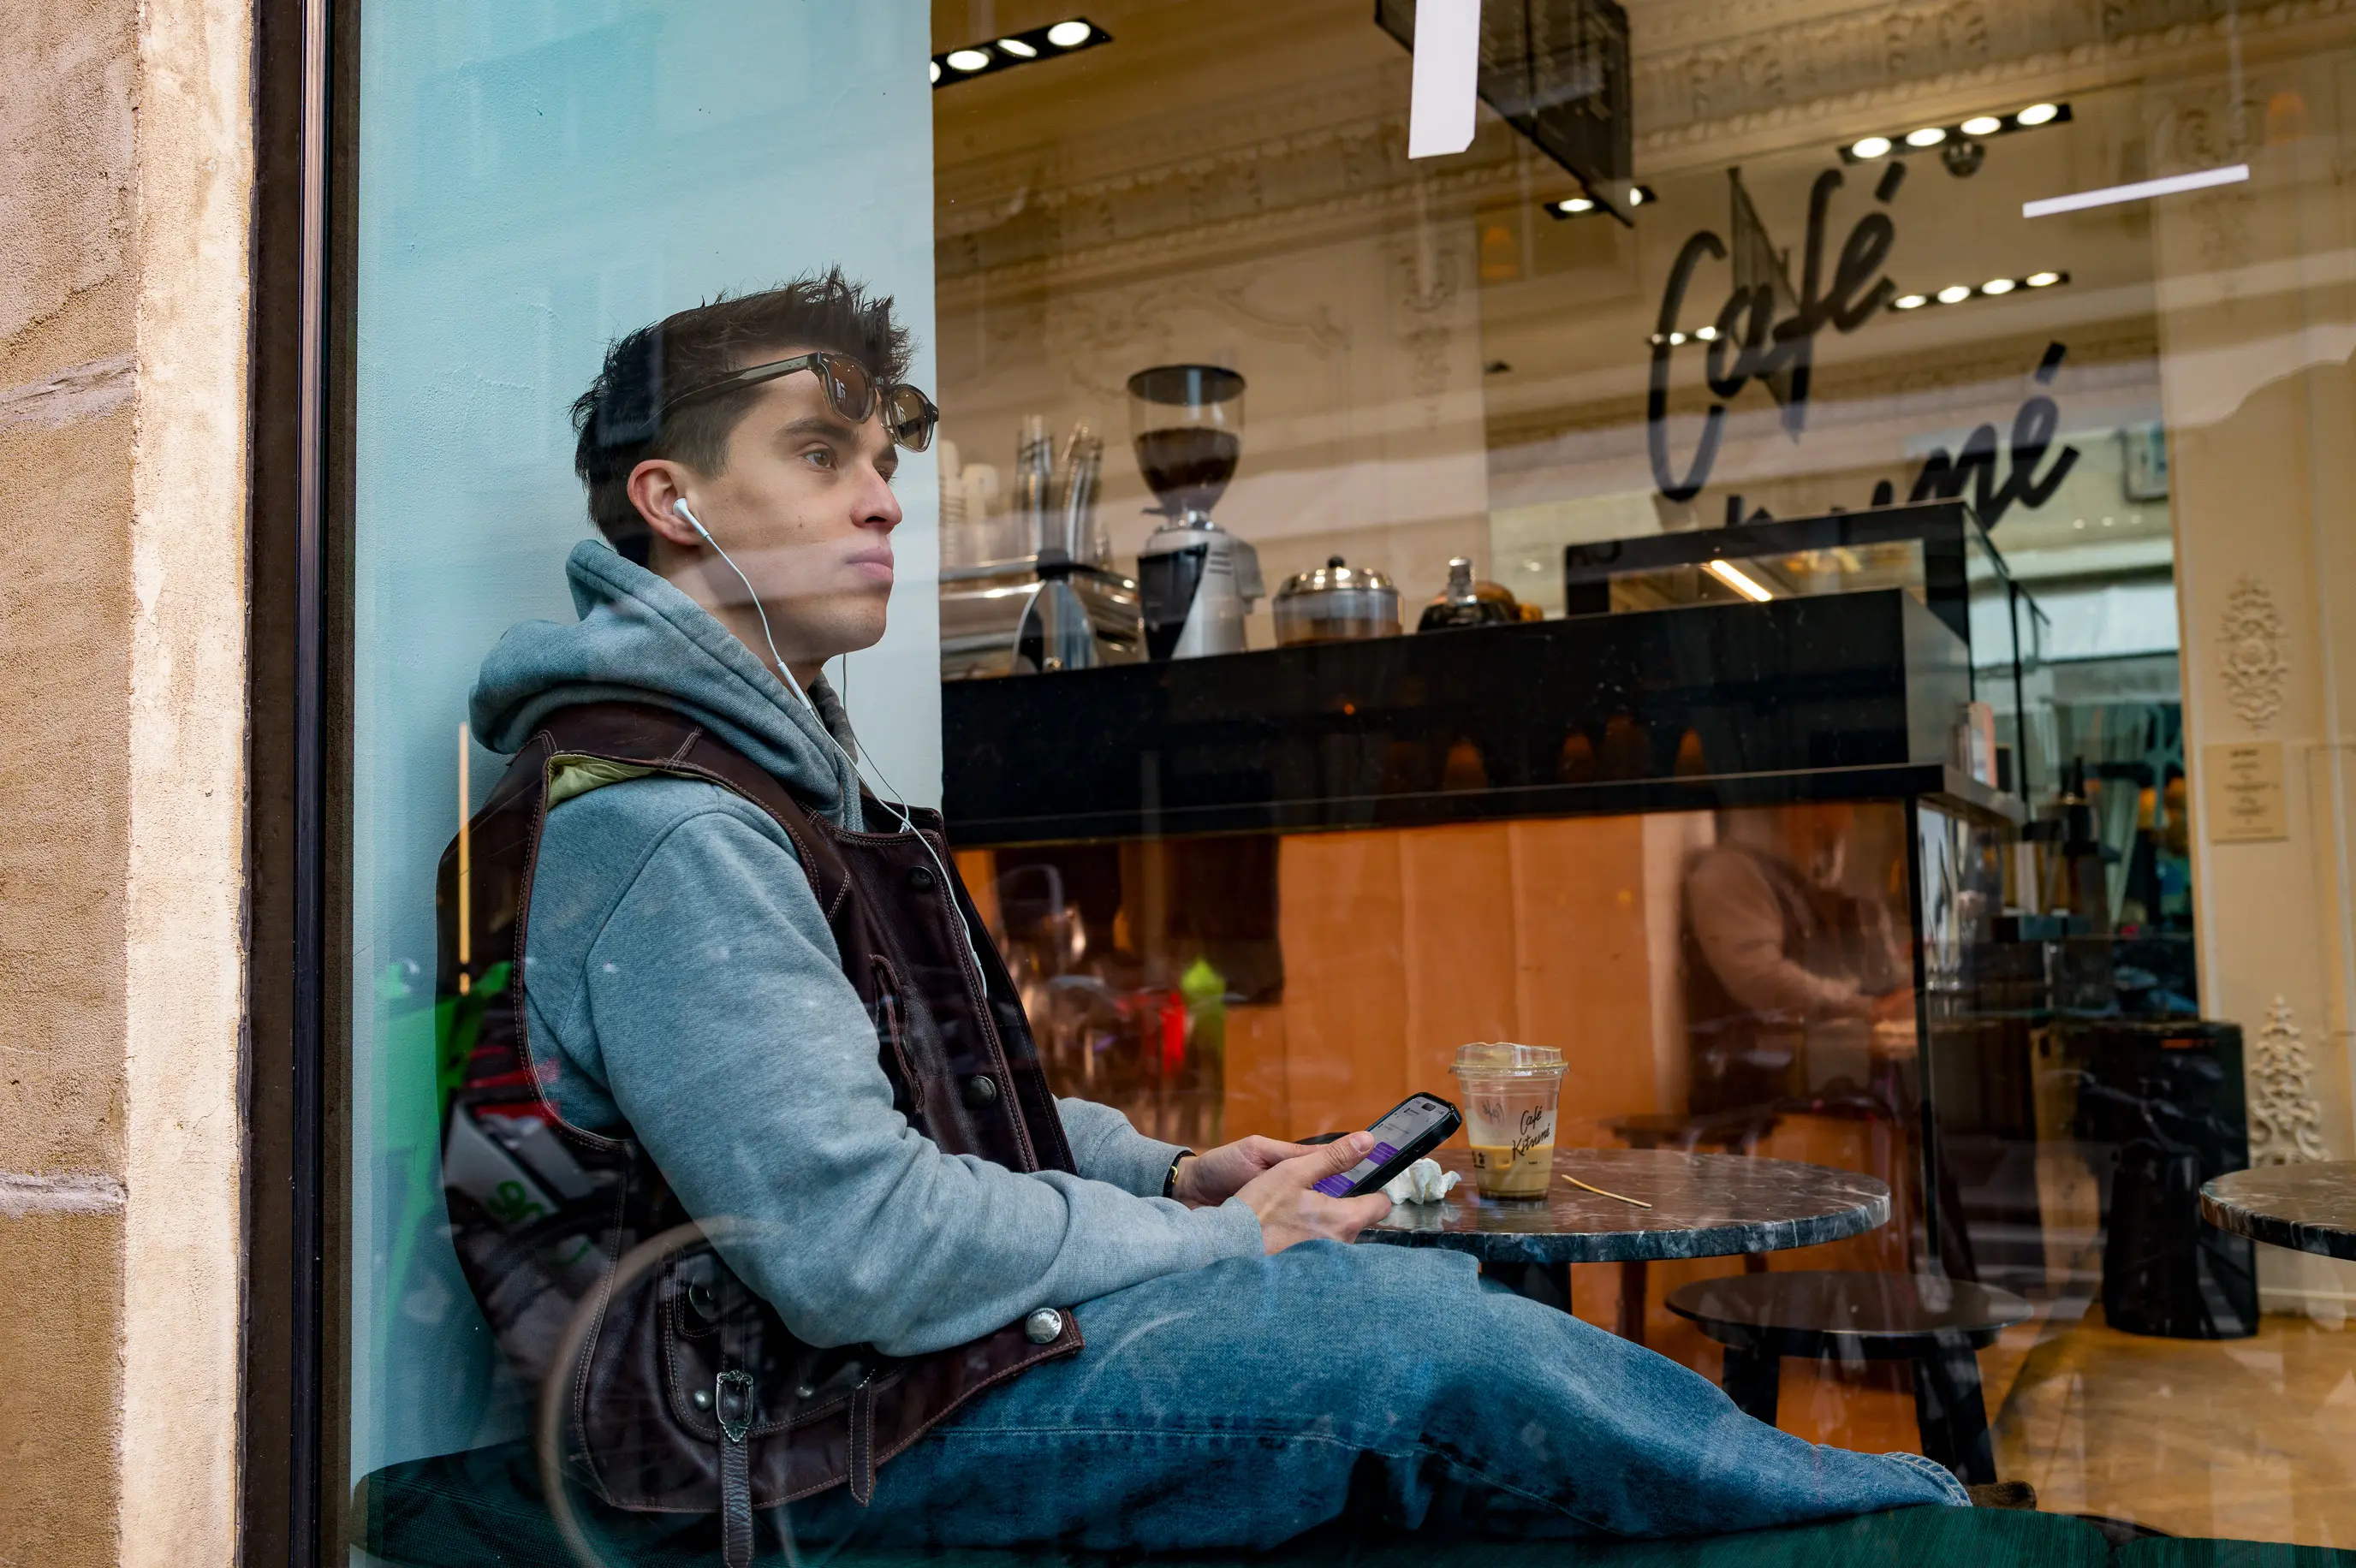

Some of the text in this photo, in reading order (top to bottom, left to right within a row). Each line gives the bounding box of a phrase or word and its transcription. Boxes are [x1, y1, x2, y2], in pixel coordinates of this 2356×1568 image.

[1647, 161, 1906, 502] Café
[1520, 1106, 1543, 1135] Café
[1512, 1123, 1550, 1161] Kitsuné
